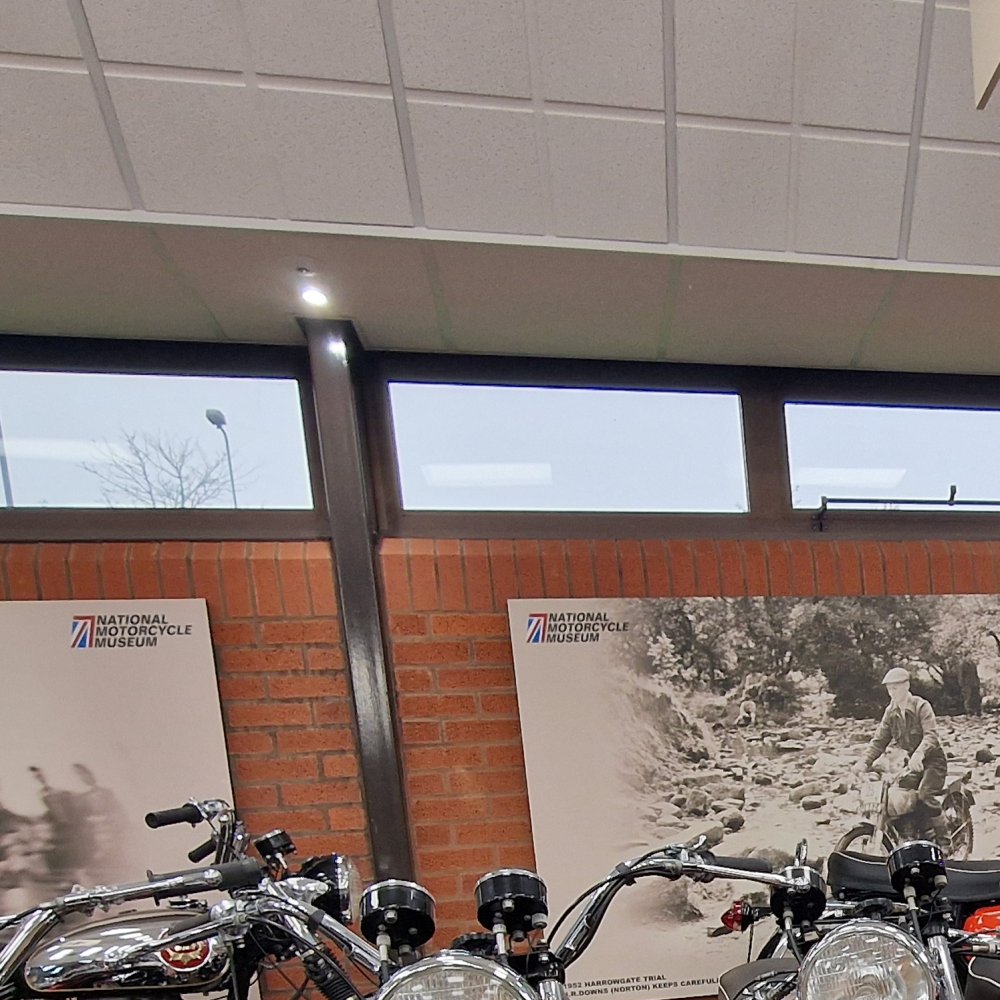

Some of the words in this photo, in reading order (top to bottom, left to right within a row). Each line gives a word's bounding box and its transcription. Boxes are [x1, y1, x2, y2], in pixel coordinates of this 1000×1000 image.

[96, 614, 168, 625] NATIONAL
[549, 612, 609, 622] NATIONAL
[95, 625, 192, 637] MOTORCYCLE
[548, 622, 629, 633] MOTORCYCLE
[94, 636, 157, 648] MUSEUM
[546, 632, 599, 643] MUSEUM
[584, 977, 641, 987] HARROWGATE
[643, 974, 666, 982] TRIAL
[610, 984, 650, 995] (NORTON)
[652, 981, 678, 990] KEEPS
